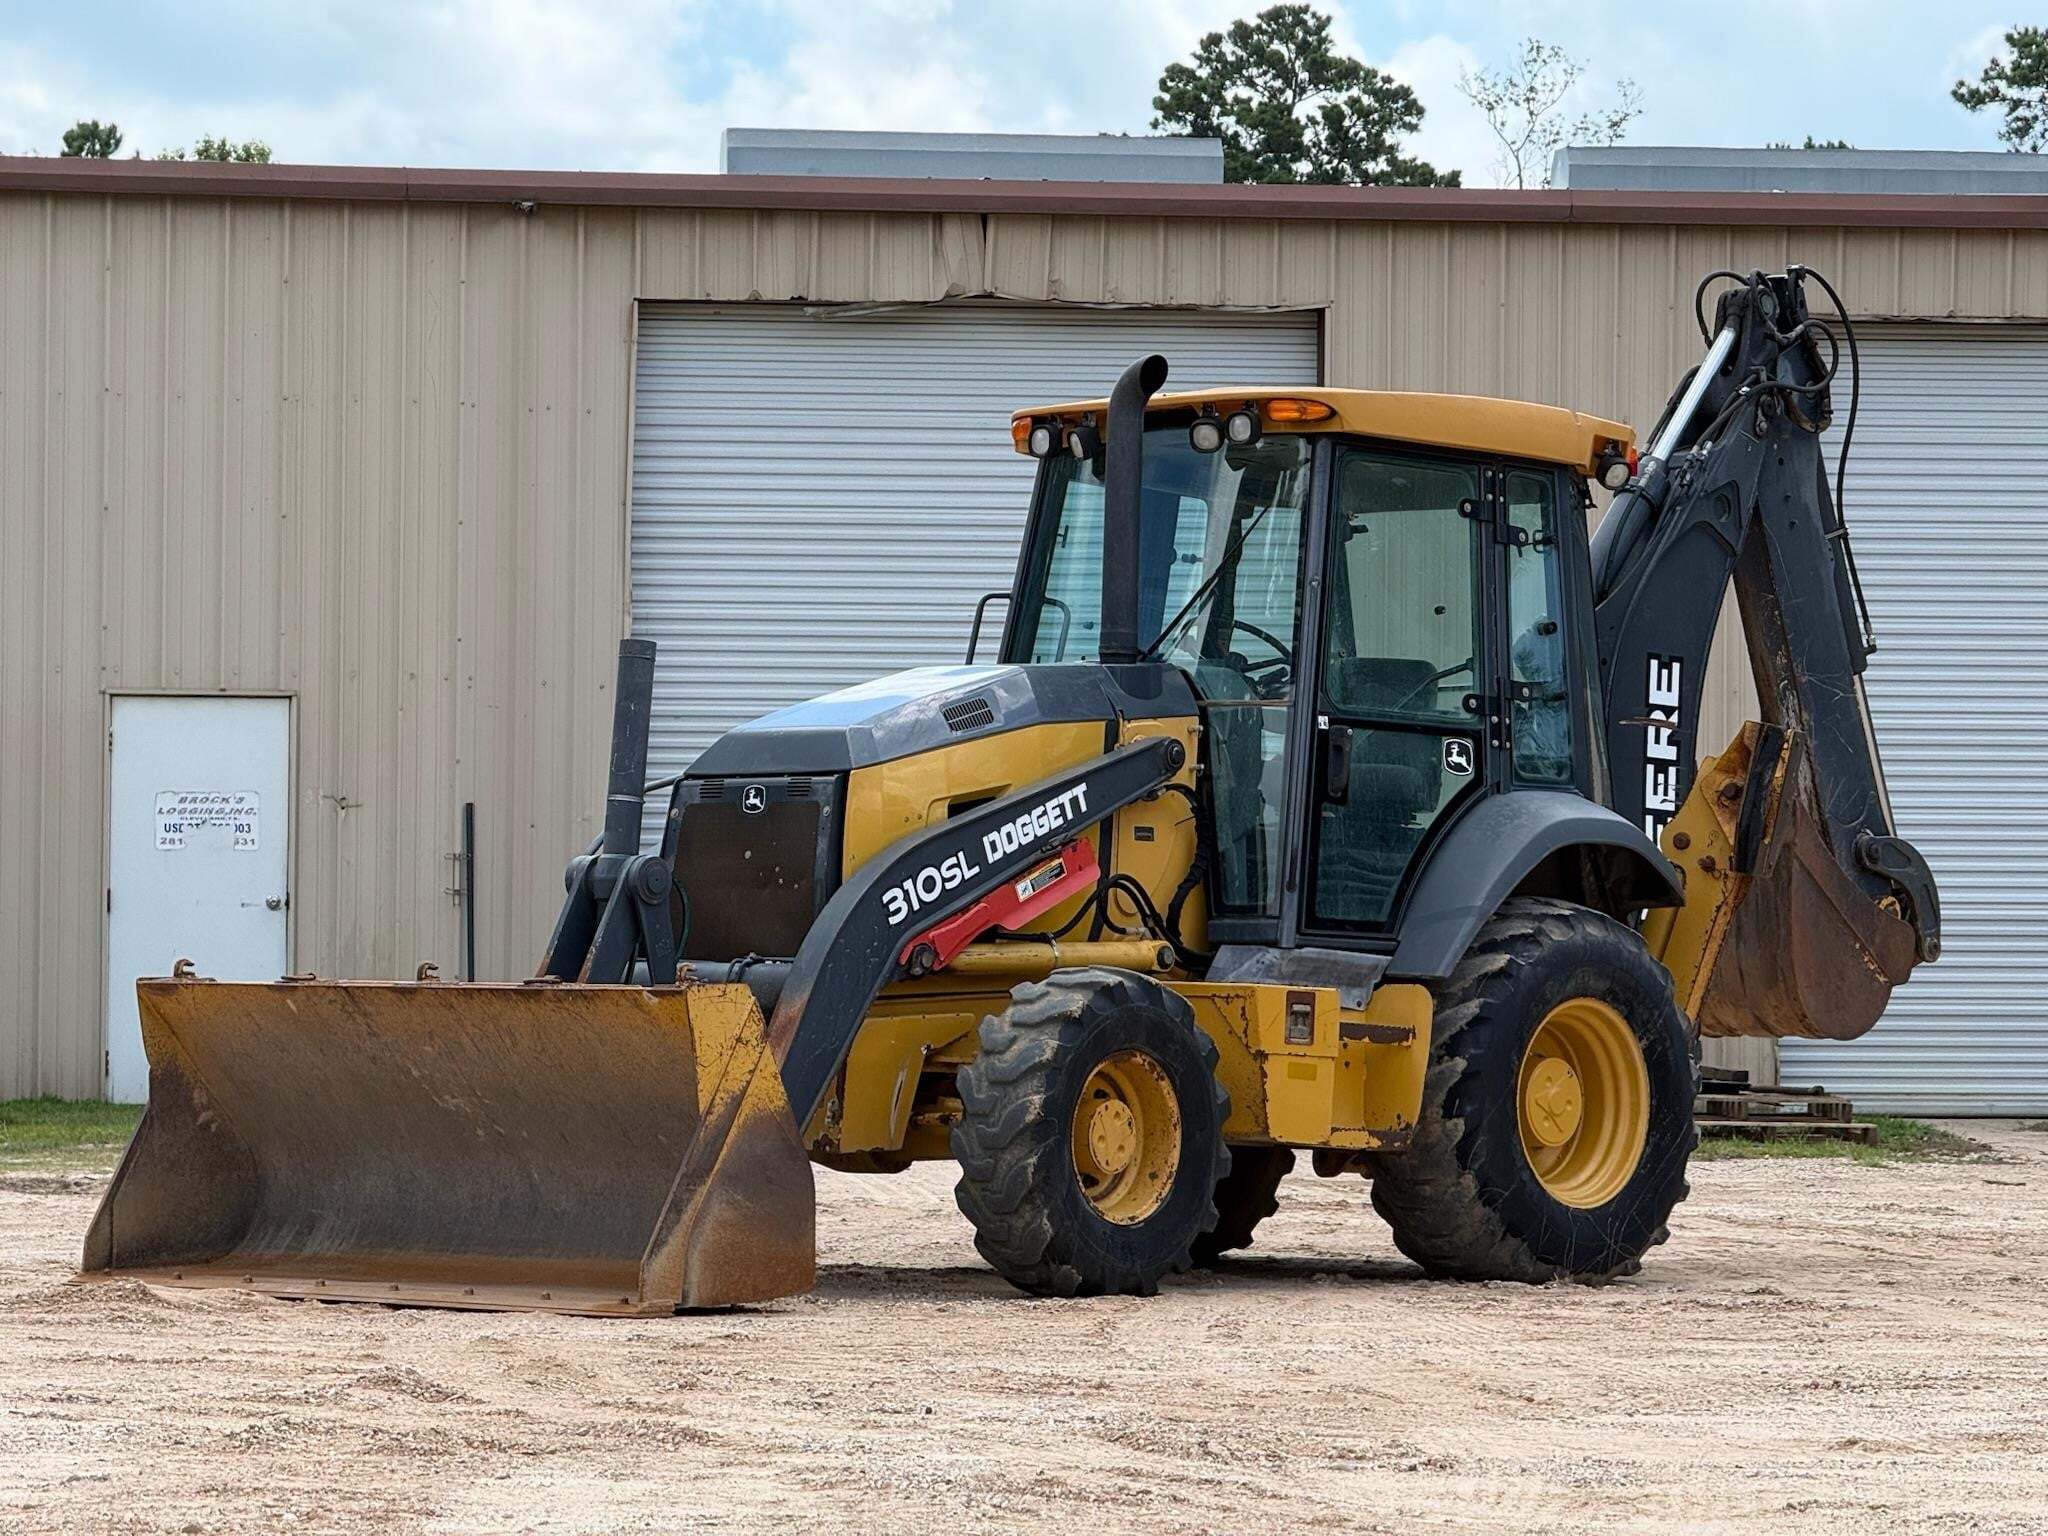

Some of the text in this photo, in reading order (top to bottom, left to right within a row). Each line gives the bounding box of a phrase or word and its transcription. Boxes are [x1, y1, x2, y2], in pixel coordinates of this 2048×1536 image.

[882, 782, 1088, 926] 310SL DOGGETT
[1641, 658, 1681, 920] ERE
